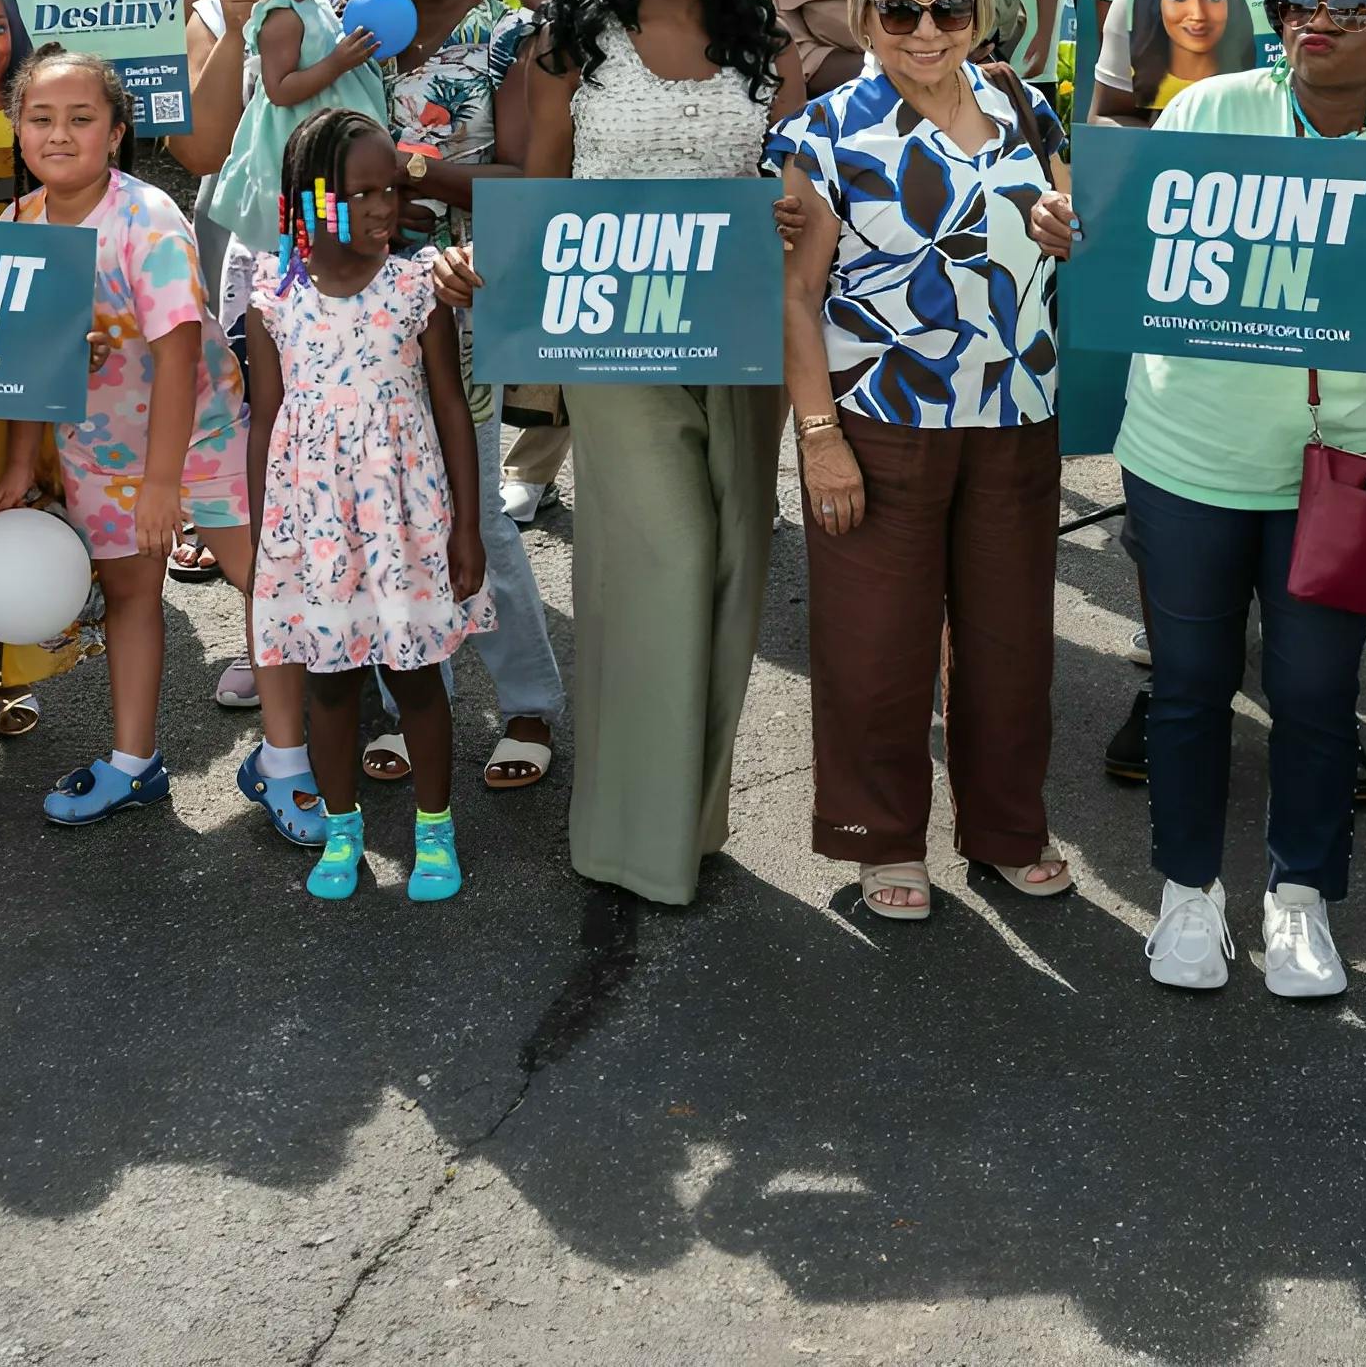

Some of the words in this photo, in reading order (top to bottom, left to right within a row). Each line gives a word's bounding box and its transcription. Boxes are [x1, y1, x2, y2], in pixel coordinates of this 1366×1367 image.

[542, 213, 730, 272] COUNT
[542, 274, 618, 334] US
[624, 275, 691, 333] IN.
[1147, 238, 1234, 306] US
[1240, 243, 1320, 312] IN.
